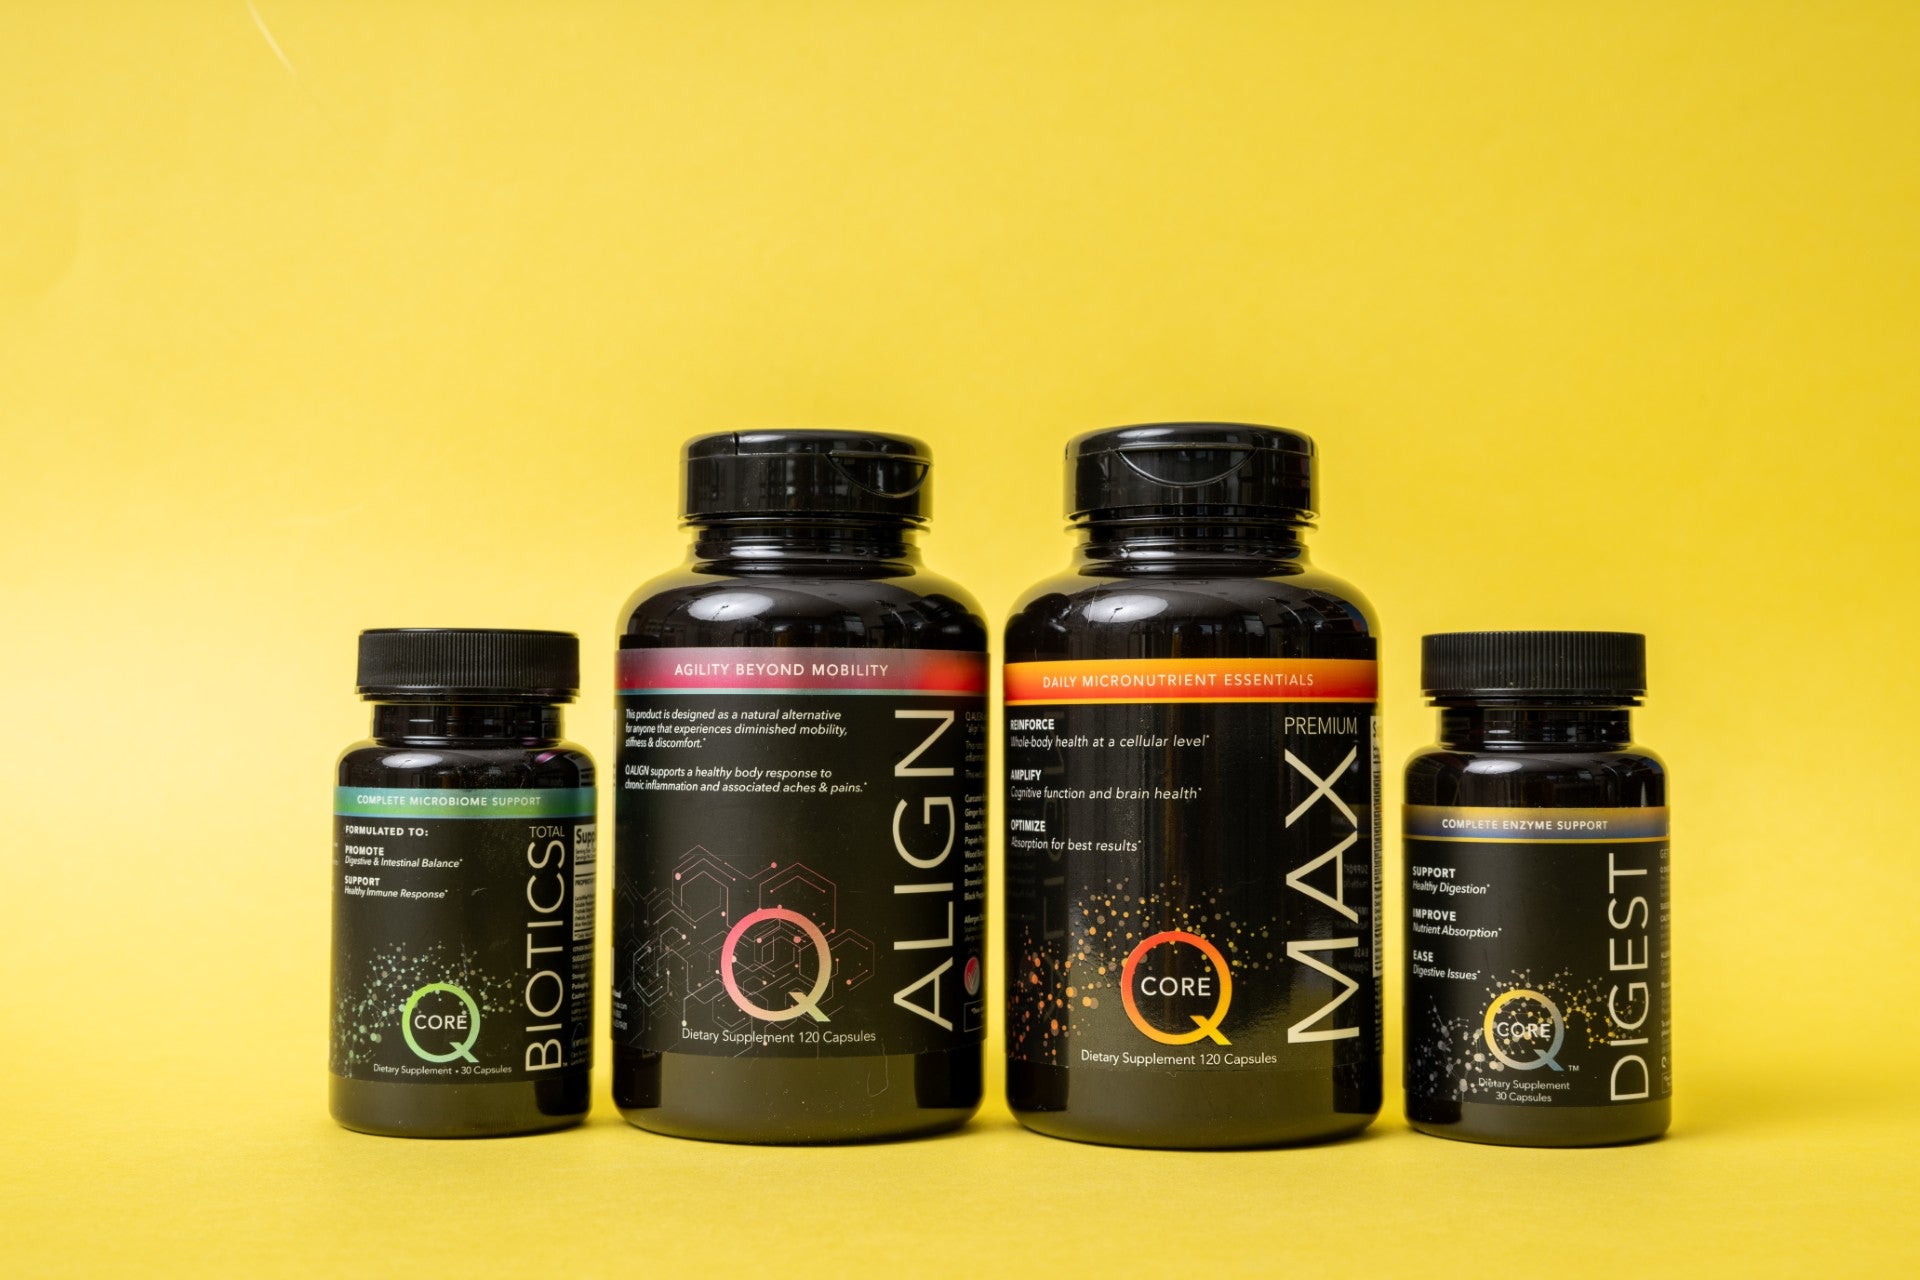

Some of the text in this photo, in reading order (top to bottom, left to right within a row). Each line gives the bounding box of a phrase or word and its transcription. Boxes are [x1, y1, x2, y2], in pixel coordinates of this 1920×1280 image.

[674, 663, 888, 676] AGILITY BEYOND MOBILITY
[1042, 673, 1313, 688] DAILY MICRONUTRIENT ESSENTIALS
[636, 709, 662, 722] product
[664, 710, 670, 719] is
[672, 709, 715, 722] designed
[718, 711, 729, 720] as
[732, 711, 738, 720] a
[741, 710, 779, 720] natural
[782, 710, 841, 720] alternative
[657, 724, 672, 734] that
[674, 724, 732, 737] experiences
[734, 724, 796, 734] diminished
[799, 724, 848, 737] mobility,
[1010, 718, 1054, 730] REINFORCE
[1284, 716, 1358, 734] PREMIUM
[648, 738, 654, 747] &
[1010, 736, 1052, 750] Whole-body
[1056, 735, 1088, 748] health
[1092, 736, 1104, 748] at
[1108, 738, 1116, 748] a
[1120, 734, 1168, 748] cellular
[650, 768, 685, 778] supports
[695, 767, 732, 779] healthy
[735, 768, 763, 779] body
[765, 770, 818, 780] response
[820, 769, 832, 778] to
[1010, 770, 1042, 781] AMPLIFY
[625, 780, 644, 790] chronic
[645, 781, 698, 790] inflammation
[700, 782, 719, 791] and
[722, 782, 780, 792] associated
[783, 782, 816, 792] aches
[819, 783, 827, 792] &
[357, 794, 541, 806] COMPLETE MICROBIOME SUPPORT
[1010, 786, 1042, 801] Cognitive
[1044, 786, 1085, 800] function
[1088, 787, 1112, 800] and
[1116, 787, 1150, 800] brain
[346, 825, 428, 836] FORMULATED TO:
[1010, 820, 1046, 832] OPTIMIZE
[1442, 818, 1608, 830] COMPLETE ENZYME SUPPORT
[529, 826, 565, 838] TOTAL
[345, 845, 384, 856] PROMOTE
[1010, 838, 1048, 851] Absorption
[1050, 839, 1065, 850] for
[1068, 840, 1092, 851] best
[344, 856, 372, 866] Digestive
[374, 857, 380, 866] &
[381, 857, 420, 867] Intestinal
[892, 710, 956, 1032] ALIGN
[1412, 866, 1456, 878] SUPPORT
[344, 876, 380, 886] SUPPORT
[1412, 880, 1438, 894] Healthy
[344, 886, 366, 898] Healthy
[366, 888, 398, 898] Immune
[1284, 745, 1360, 1043] MAX
[1412, 908, 1456, 922] IMPROVE
[1412, 922, 1440, 935] Nutrient
[525, 840, 566, 1071] BIOTICS
[1413, 950, 1434, 962] EASE
[1413, 964, 1446, 978] Digestive
[1608, 853, 1649, 1100] DIGEST
[1120, 930, 1232, 1046] Q
[1140, 976, 1211, 997] CORE
[402, 982, 480, 1063] Q
[414, 1014, 468, 1030] CORE
[682, 1028, 876, 1044] Dietary Supplement 120 Capsules
[1484, 989, 1564, 1072] Q
[1496, 1022, 1550, 1038] CORE
[1081, 1050, 1277, 1066] Dietary Supplement 120 Capsules
[374, 1064, 512, 1076] Dietary Supplement 30 Capsules
[1478, 1078, 1570, 1091] Dietary Supplement
[1496, 1092, 1552, 1102] 30 Capsules
